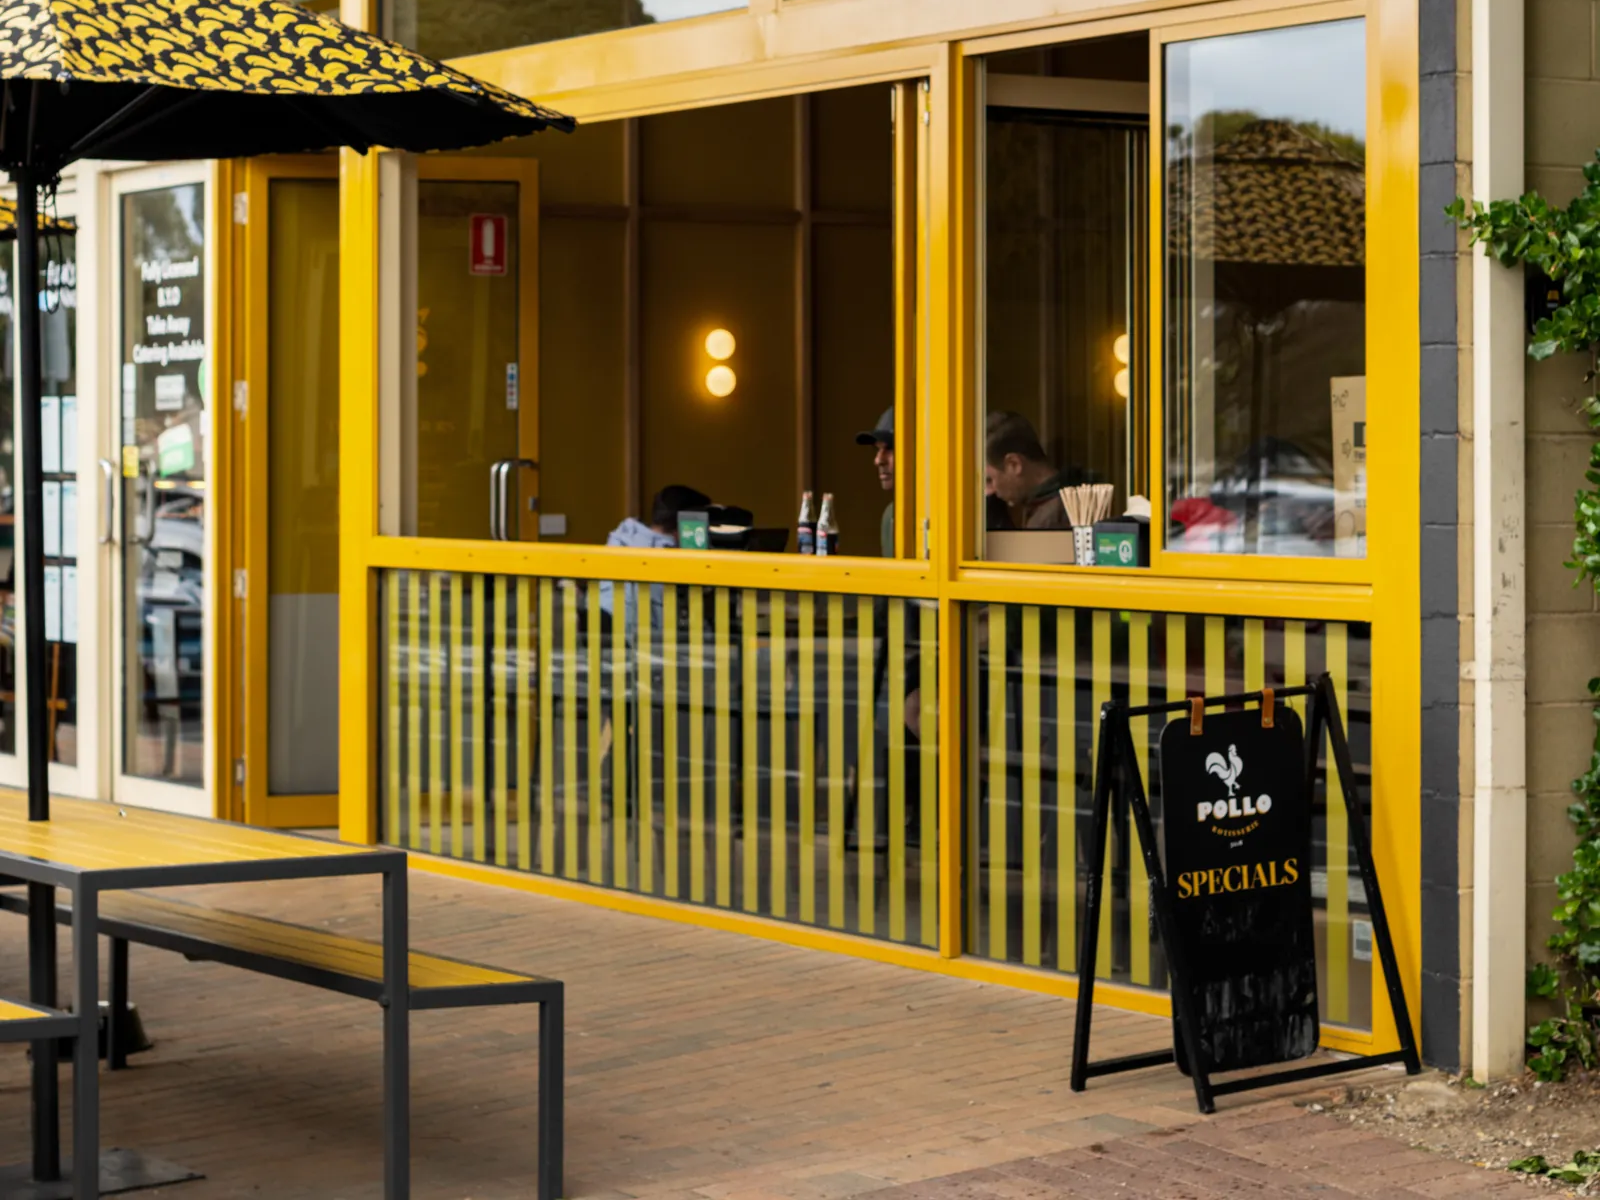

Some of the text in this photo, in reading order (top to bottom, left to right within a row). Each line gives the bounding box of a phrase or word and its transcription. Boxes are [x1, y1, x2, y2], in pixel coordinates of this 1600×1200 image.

[1197, 794, 1272, 822] POLLO
[1211, 820, 1259, 836] ROTISSERIE
[1177, 857, 1300, 899] SPECIALS
